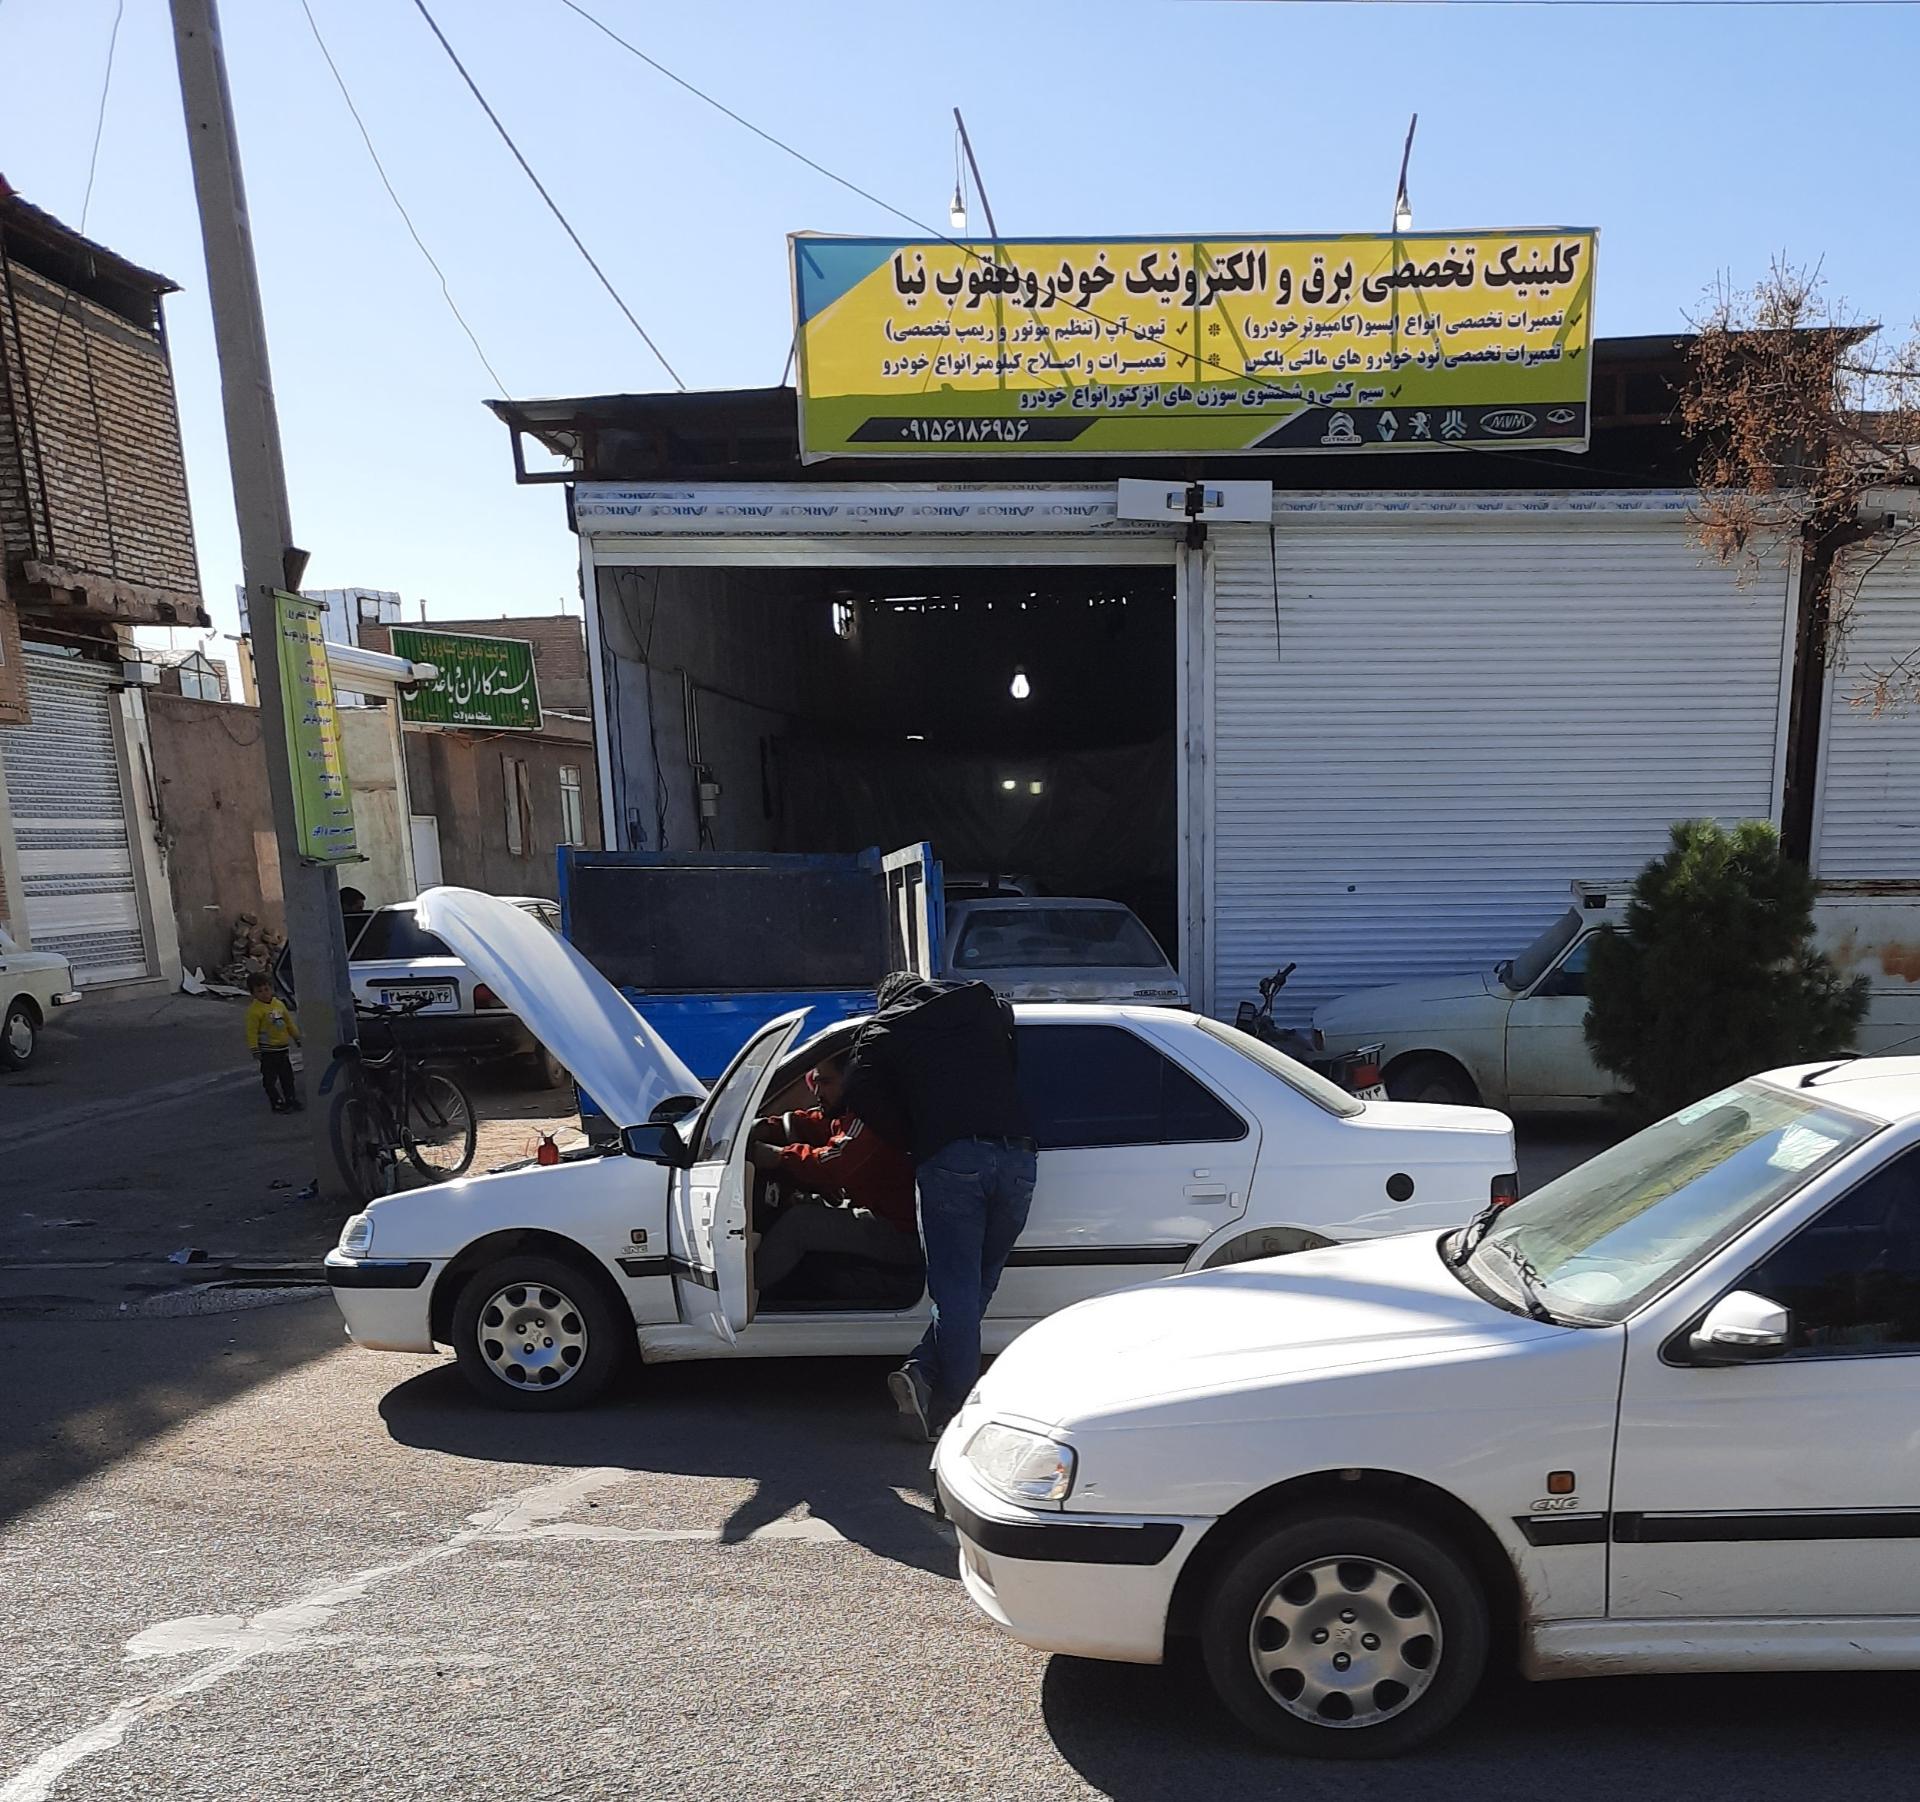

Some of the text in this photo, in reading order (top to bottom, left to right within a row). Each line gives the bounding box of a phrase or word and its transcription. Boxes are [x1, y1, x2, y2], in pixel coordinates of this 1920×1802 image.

[895, 253, 926, 306] نیا
[1126, 249, 1266, 306] الکترونیک
[1302, 257, 1353, 304] برق
[1363, 247, 1475, 302] تخصصی
[1485, 243, 1580, 296] کلینیک
[1276, 269, 1291, 304] و
[886, 317, 1165, 343] تیون آپ (تنظیم موتور و ریمپ تخصصی)
[1405, 314, 1441, 335] انواع
[1446, 312, 1503, 334] تخصصی
[1507, 310, 1563, 332] تعمیرات
[883, 353, 929, 375] خودرو
[1027, 352, 1081, 373] اصلاح
[1086, 359, 1093, 373] و
[1099, 352, 1166, 373] تعمیرات
[1245, 350, 1284, 372] پلکس
[1289, 349, 1328, 371] مالتی
[1332, 348, 1360, 370] های
[1366, 347, 1412, 370] خودرو
[1444, 345, 1501, 368] تخصصی
[1505, 344, 1561, 366] تعمیرات
[1020, 387, 1067, 408] خودرو
[1164, 385, 1192, 406] های
[1197, 386, 1237, 406] سوزن
[1242, 384, 1302, 405] شستشوی
[1306, 389, 1315, 405] و
[1320, 382, 1354, 404] کشی
[1358, 386, 1384, 403] سیم
[901, 419, 1029, 441] ۰۹۱۵۶۱۸۶۹۵۶
[1490, 414, 1526, 429] MVM
[455, 665, 499, 704] کاران
[492, 669, 530, 710] پسته
